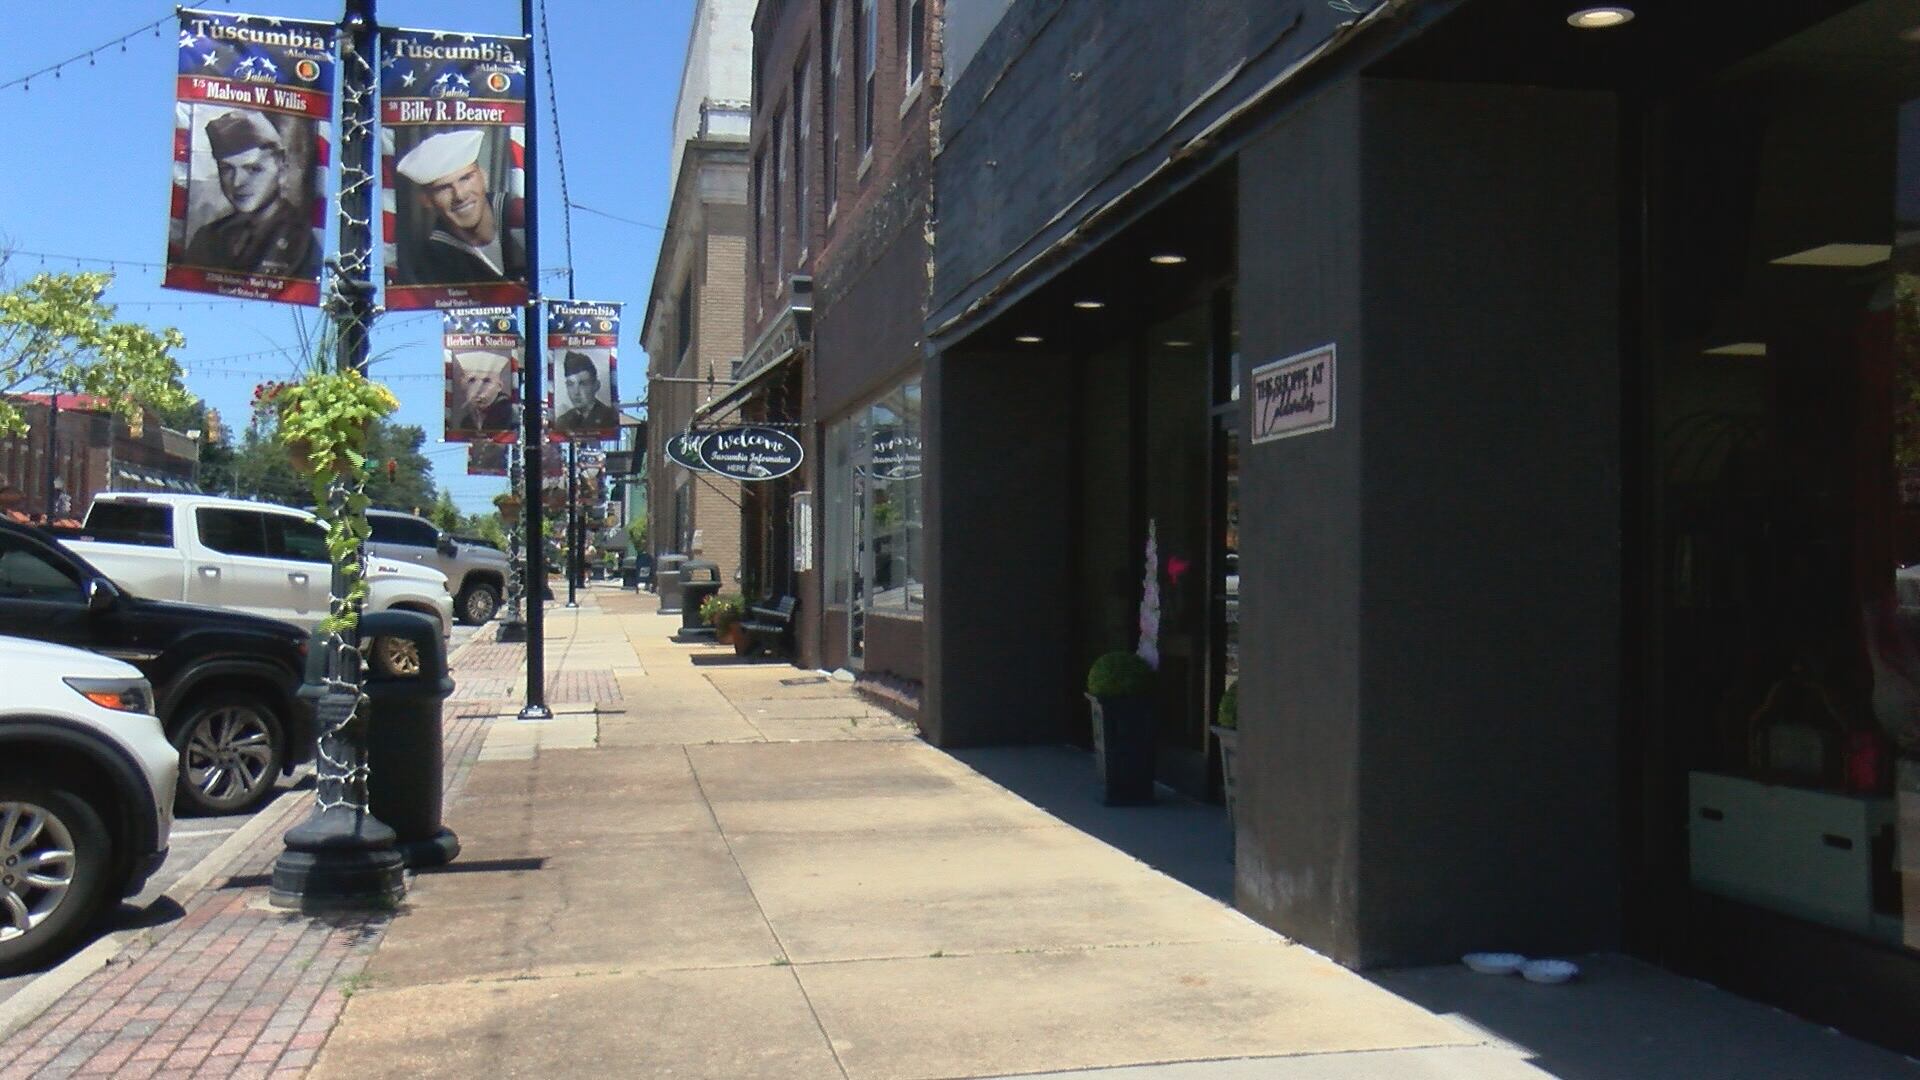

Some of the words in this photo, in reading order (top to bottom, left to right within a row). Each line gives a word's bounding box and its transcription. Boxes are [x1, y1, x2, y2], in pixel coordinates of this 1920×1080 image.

[191, 19, 325, 50] Tuscumbia
[391, 38, 515, 63] Tuscumbia
[206, 81, 252, 103] Malvon
[254, 86, 271, 106] W.
[273, 89, 308, 111] Willis
[400, 101, 432, 124] Billy
[436, 101, 451, 121] R.
[456, 101, 506, 122] Beaver
[553, 304, 616, 316] Tuscumbia
[446, 335, 475, 347] Herbert
[1311, 362, 1325, 387] AT
[718, 427, 786, 452] Welcome
